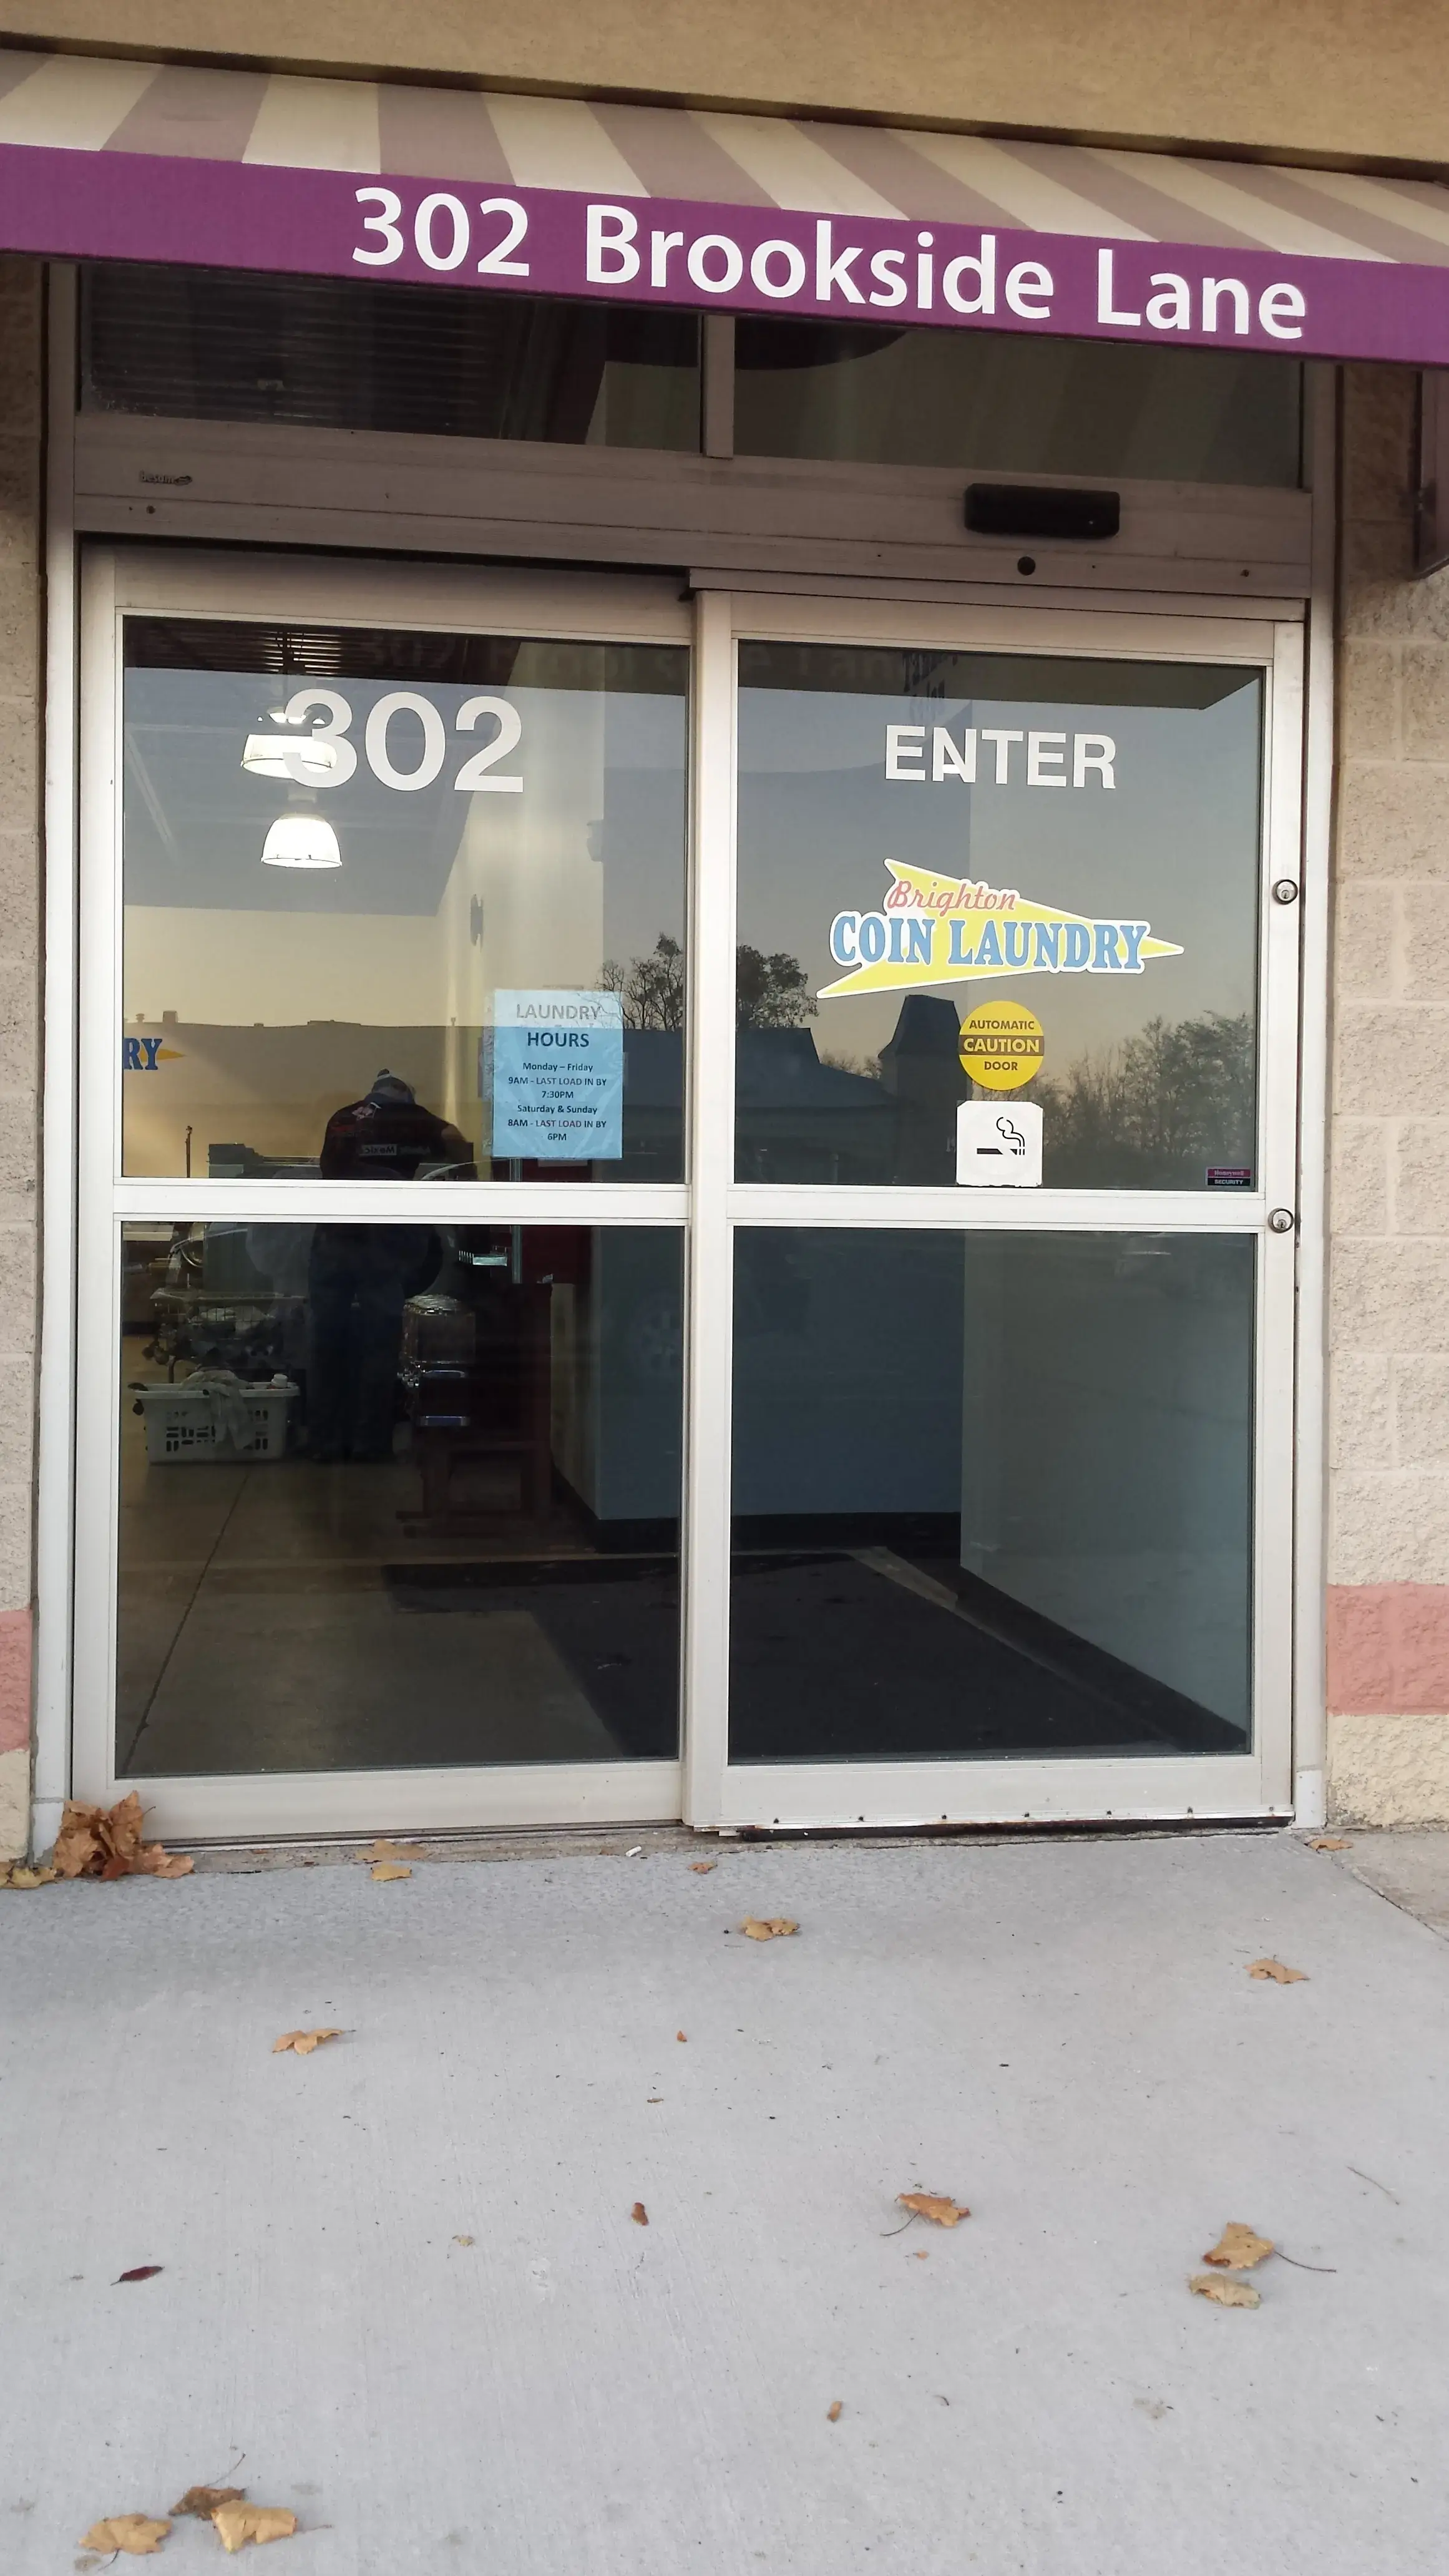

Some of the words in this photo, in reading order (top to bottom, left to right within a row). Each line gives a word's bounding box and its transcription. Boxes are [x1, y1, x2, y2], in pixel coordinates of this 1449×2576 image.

[352, 187, 529, 276] 302
[585, 204, 1054, 320] Brookside
[1096, 248, 1306, 340] Lane
[282, 688, 524, 793] 302
[885, 724, 1117, 789] ENTER
[886, 880, 1017, 917] Brighton
[832, 916, 936, 965] COIN
[947, 920, 1148, 970] LAUNDRY
[516, 1003, 601, 1020] LAUNDRY
[968, 1020, 1035, 1030] AUTOMATIC
[527, 1032, 590, 1047] HOURS
[963, 1038, 1040, 1053] CAUTION
[522, 1062, 558, 1072] Monday
[567, 1063, 593, 1073] Friday
[983, 1061, 1018, 1071] DOOR
[559, 1078, 582, 1086] LOAD
[596, 1078, 607, 1086] BY
[541, 1091, 574, 1099] 7:30PM
[517, 1105, 555, 1113] Saturday
[566, 1105, 598, 1115] Sunday
[508, 1119, 528, 1127] 8AM
